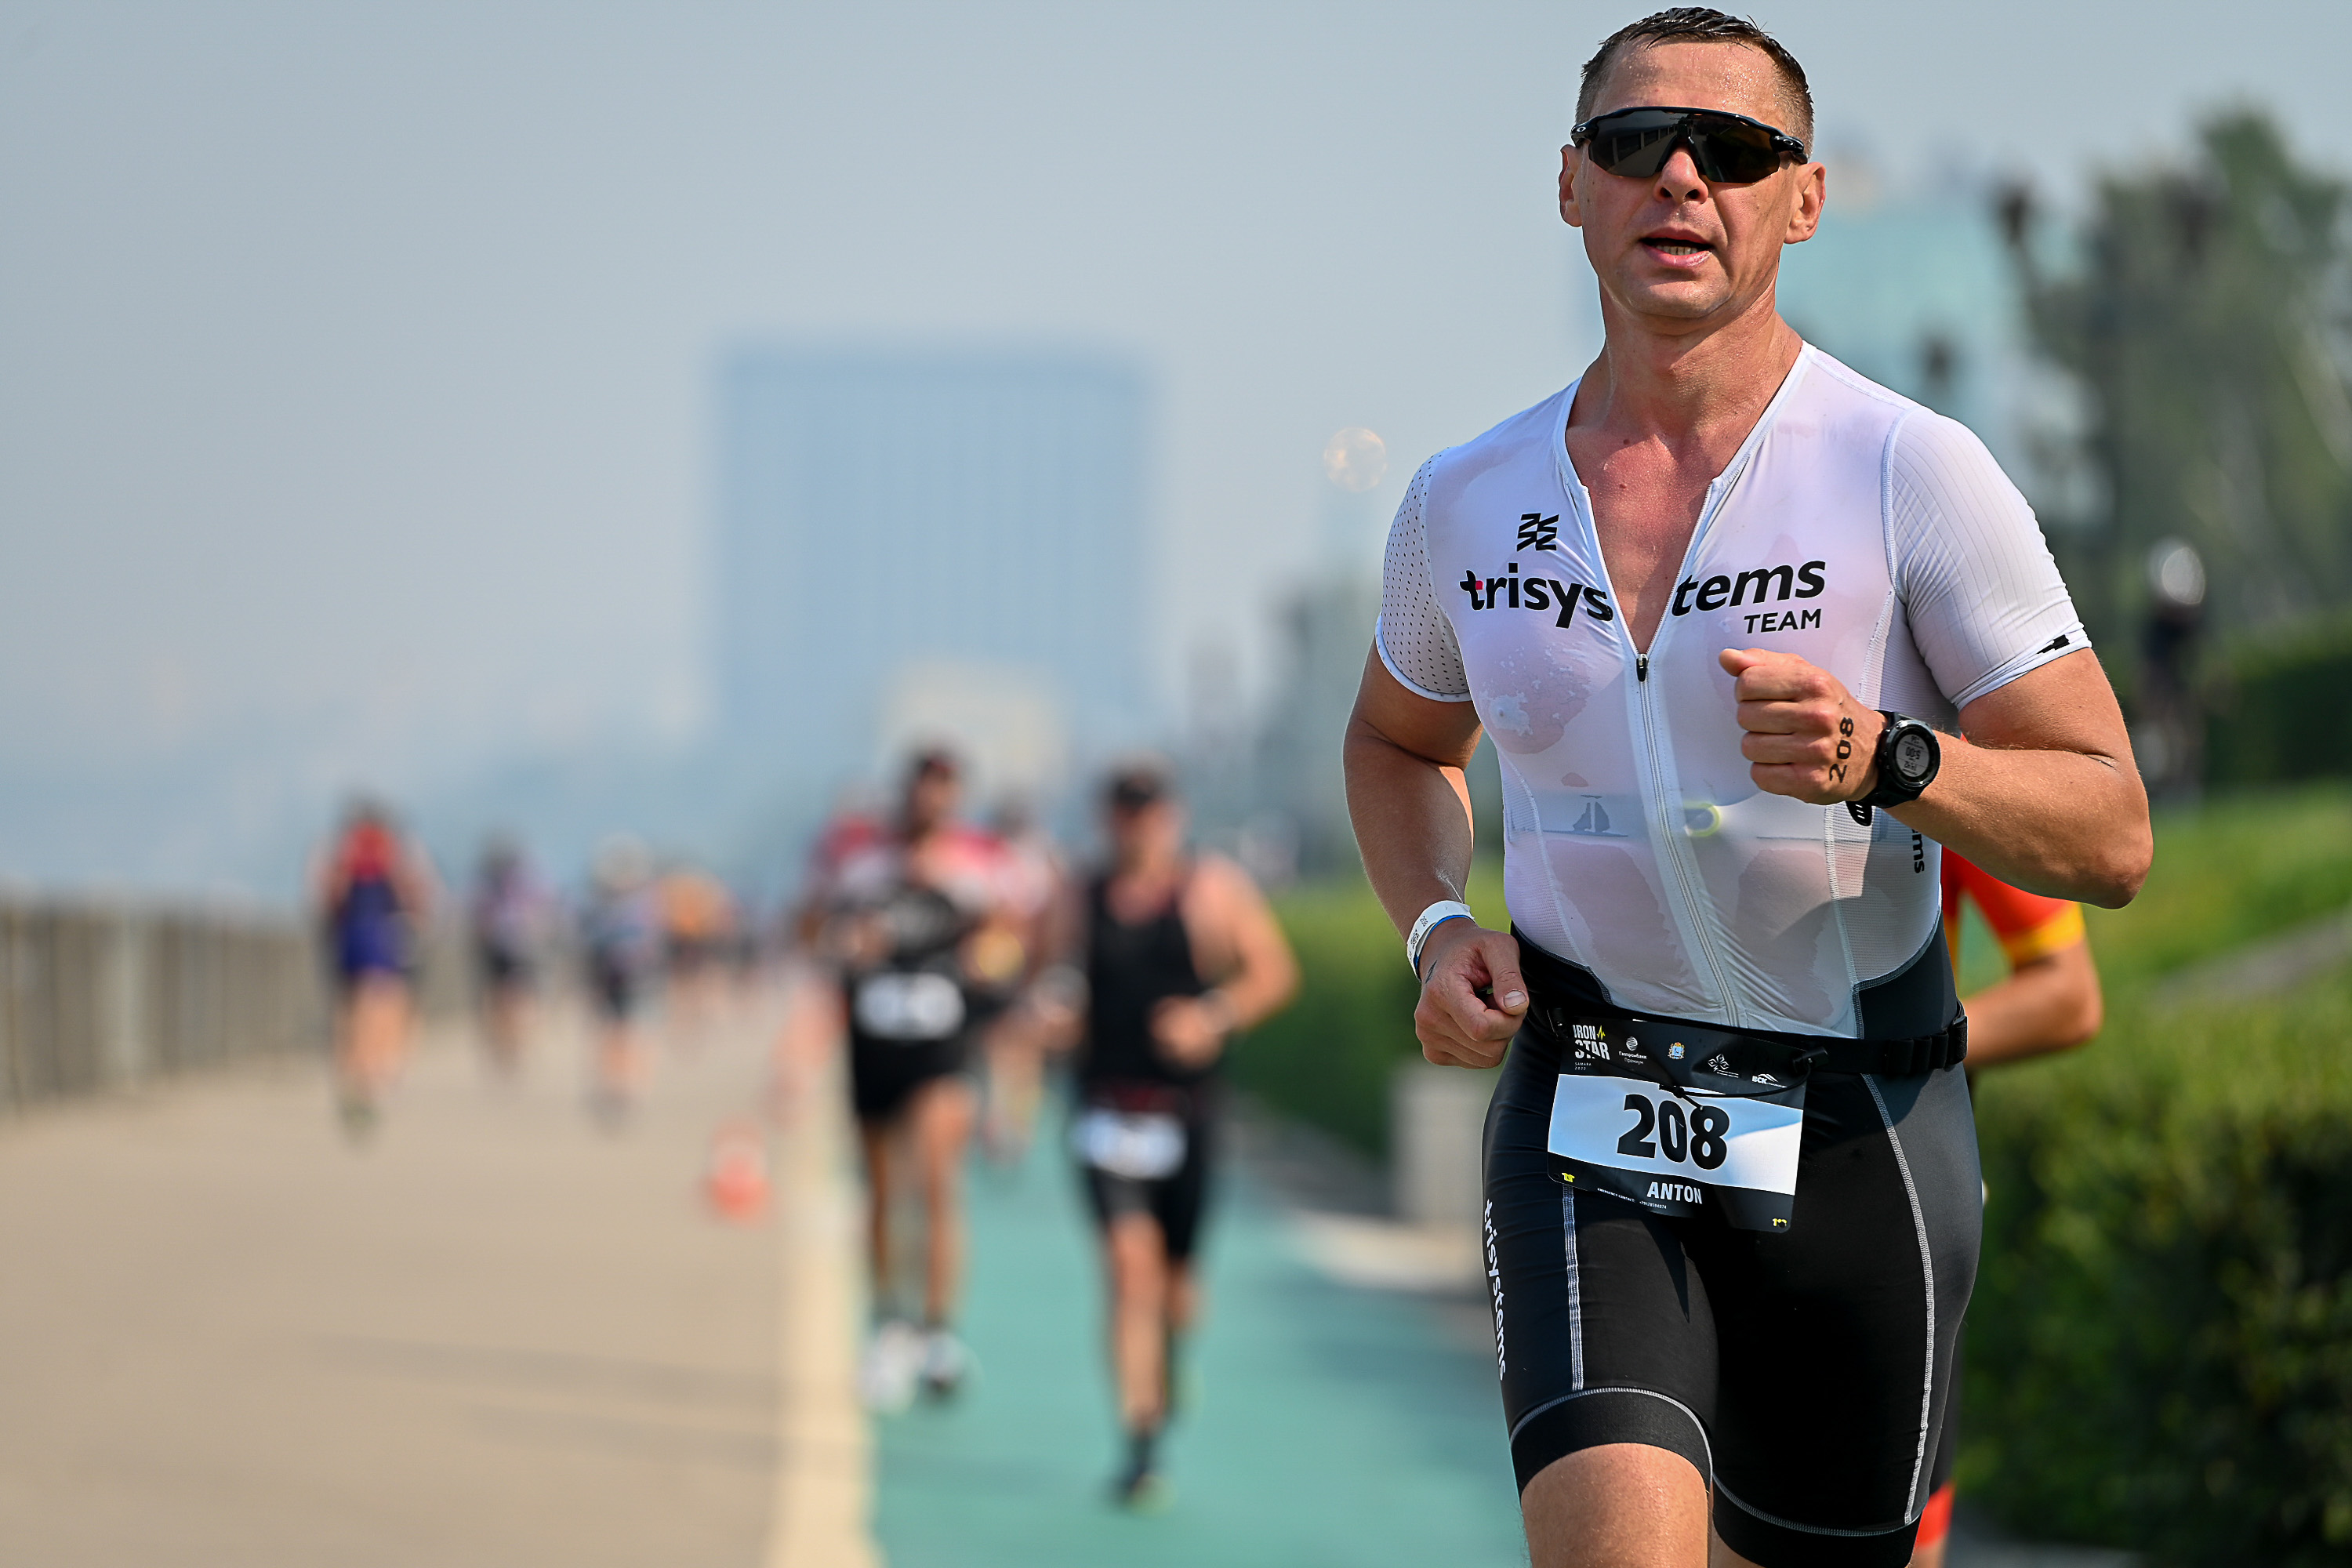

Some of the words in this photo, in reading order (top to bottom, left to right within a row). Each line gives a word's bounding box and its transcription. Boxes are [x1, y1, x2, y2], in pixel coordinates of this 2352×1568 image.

[1460, 562, 1613, 629] trisys
[1671, 561, 1826, 616] tems
[1744, 608, 1821, 634] TEAM
[1829, 717, 1854, 783] 208
[1573, 1025, 1596, 1040] IRON
[1574, 1040, 1610, 1060] STAR
[1617, 1094, 1730, 1170] 208
[1646, 1181, 1702, 1204] ANTON
[1484, 1199, 1506, 1381] trisystems
